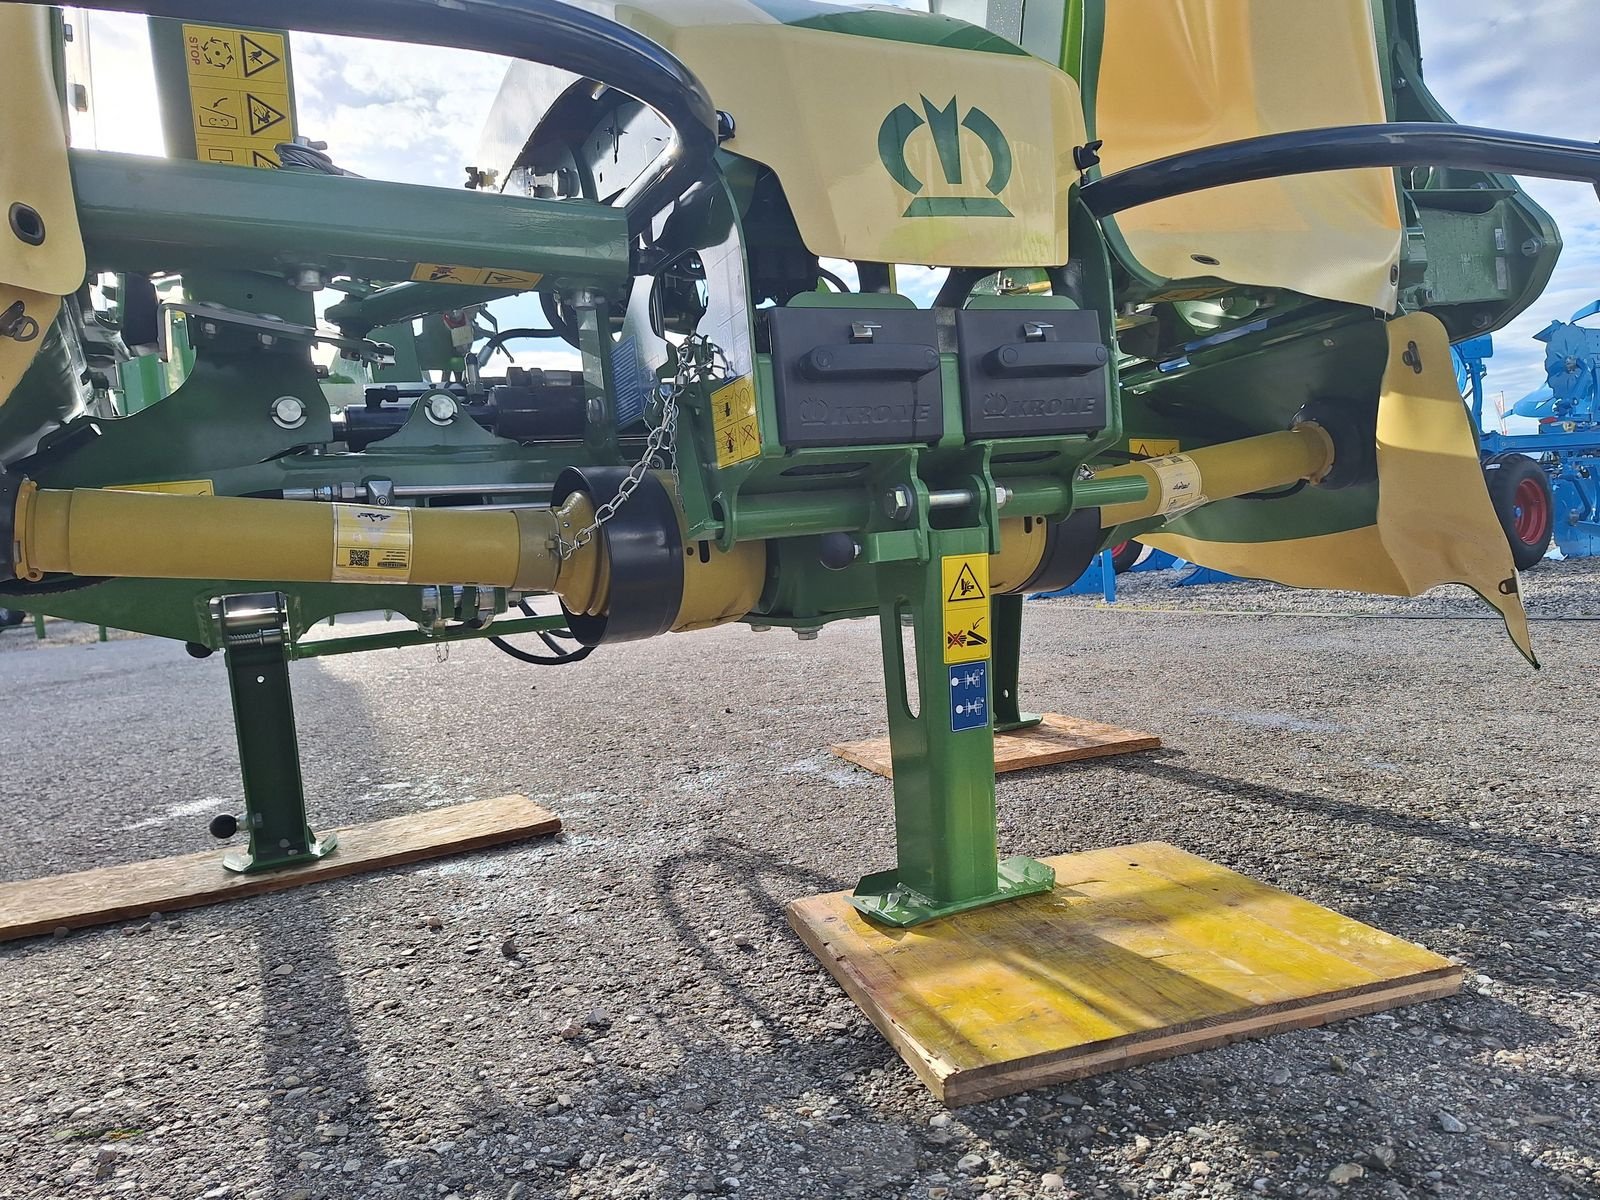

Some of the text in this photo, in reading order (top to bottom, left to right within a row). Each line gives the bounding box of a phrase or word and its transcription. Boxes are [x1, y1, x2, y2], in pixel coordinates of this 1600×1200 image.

[189, 36, 201, 65] STOP
[831, 404, 931, 425] KRONE
[1009, 397, 1096, 418] KRONE
